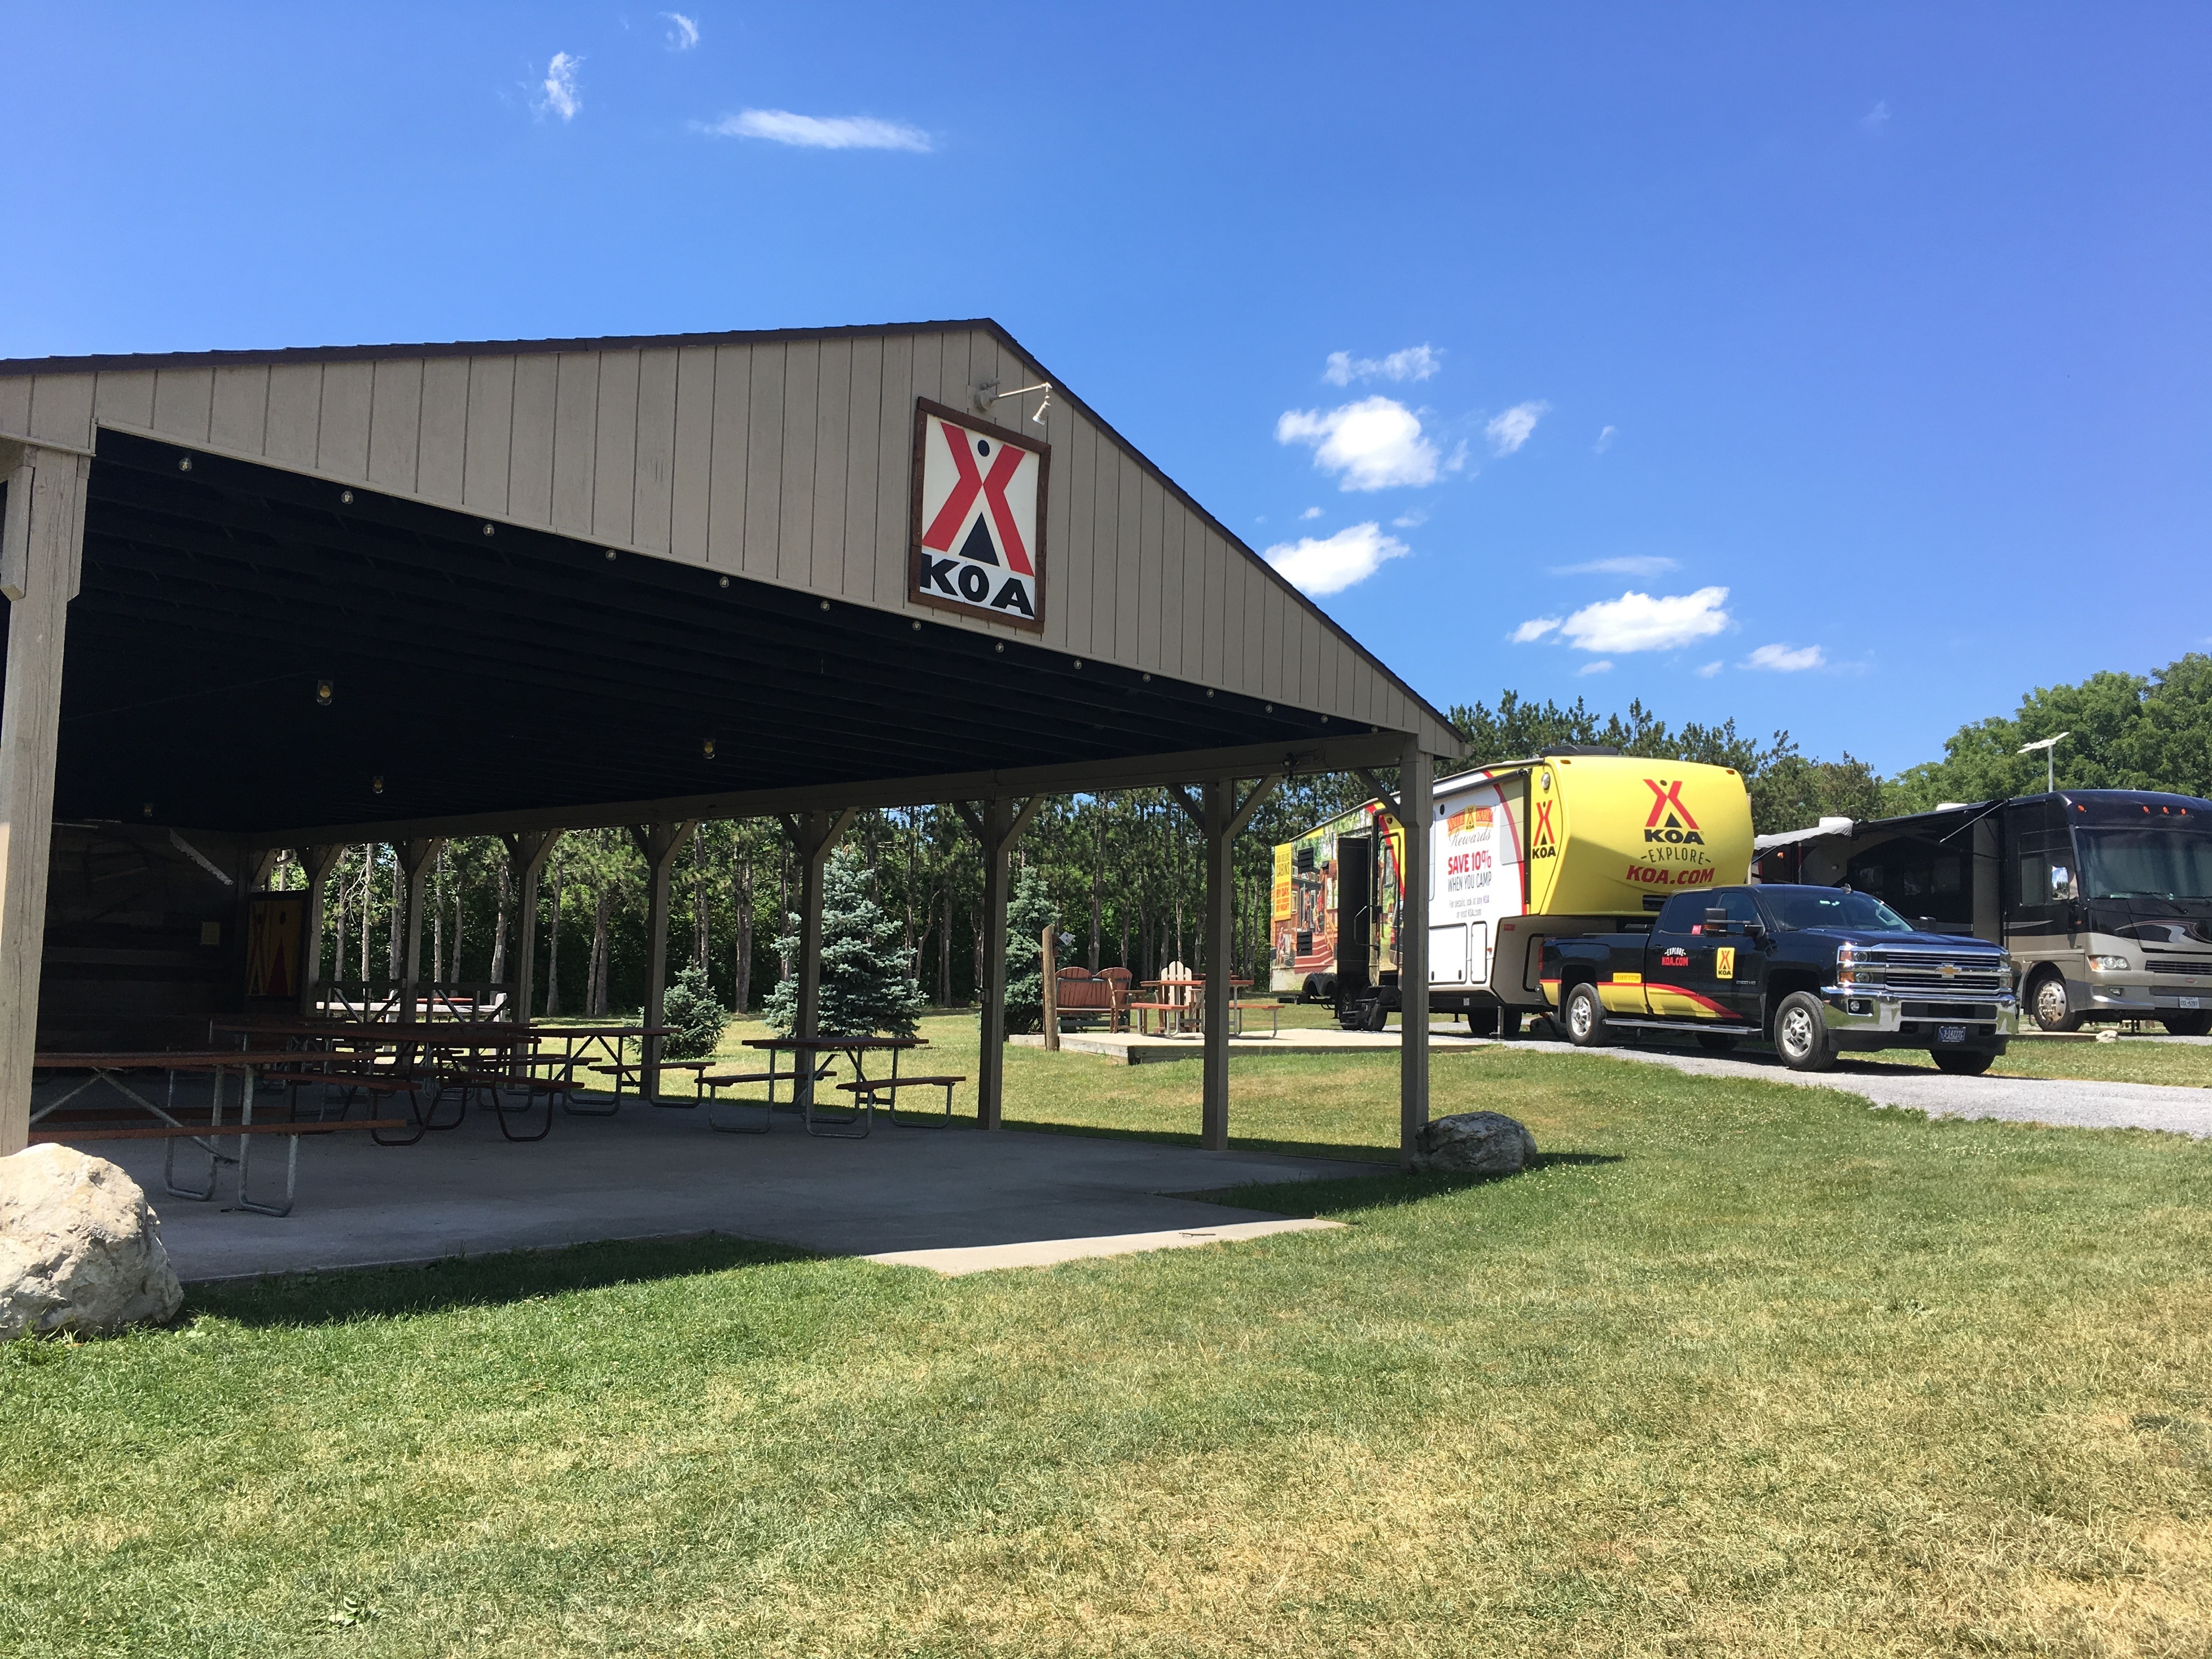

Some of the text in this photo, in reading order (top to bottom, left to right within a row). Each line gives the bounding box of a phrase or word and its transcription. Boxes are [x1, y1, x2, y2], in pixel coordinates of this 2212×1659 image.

[920, 552, 1035, 617] KOA
[1448, 815, 1464, 830] VALUE
[1449, 820, 1492, 847] Rewards
[1644, 829, 1705, 845] KOA
[1532, 846, 1556, 859] KOA
[1276, 861, 1290, 877] CABINS
[1448, 849, 1491, 876] SAVE 10%
[1448, 871, 1491, 893] WHEN YOU CAMP
[1626, 865, 1716, 885] KOA.COM
[1662, 957, 1689, 966] KOA.COM
